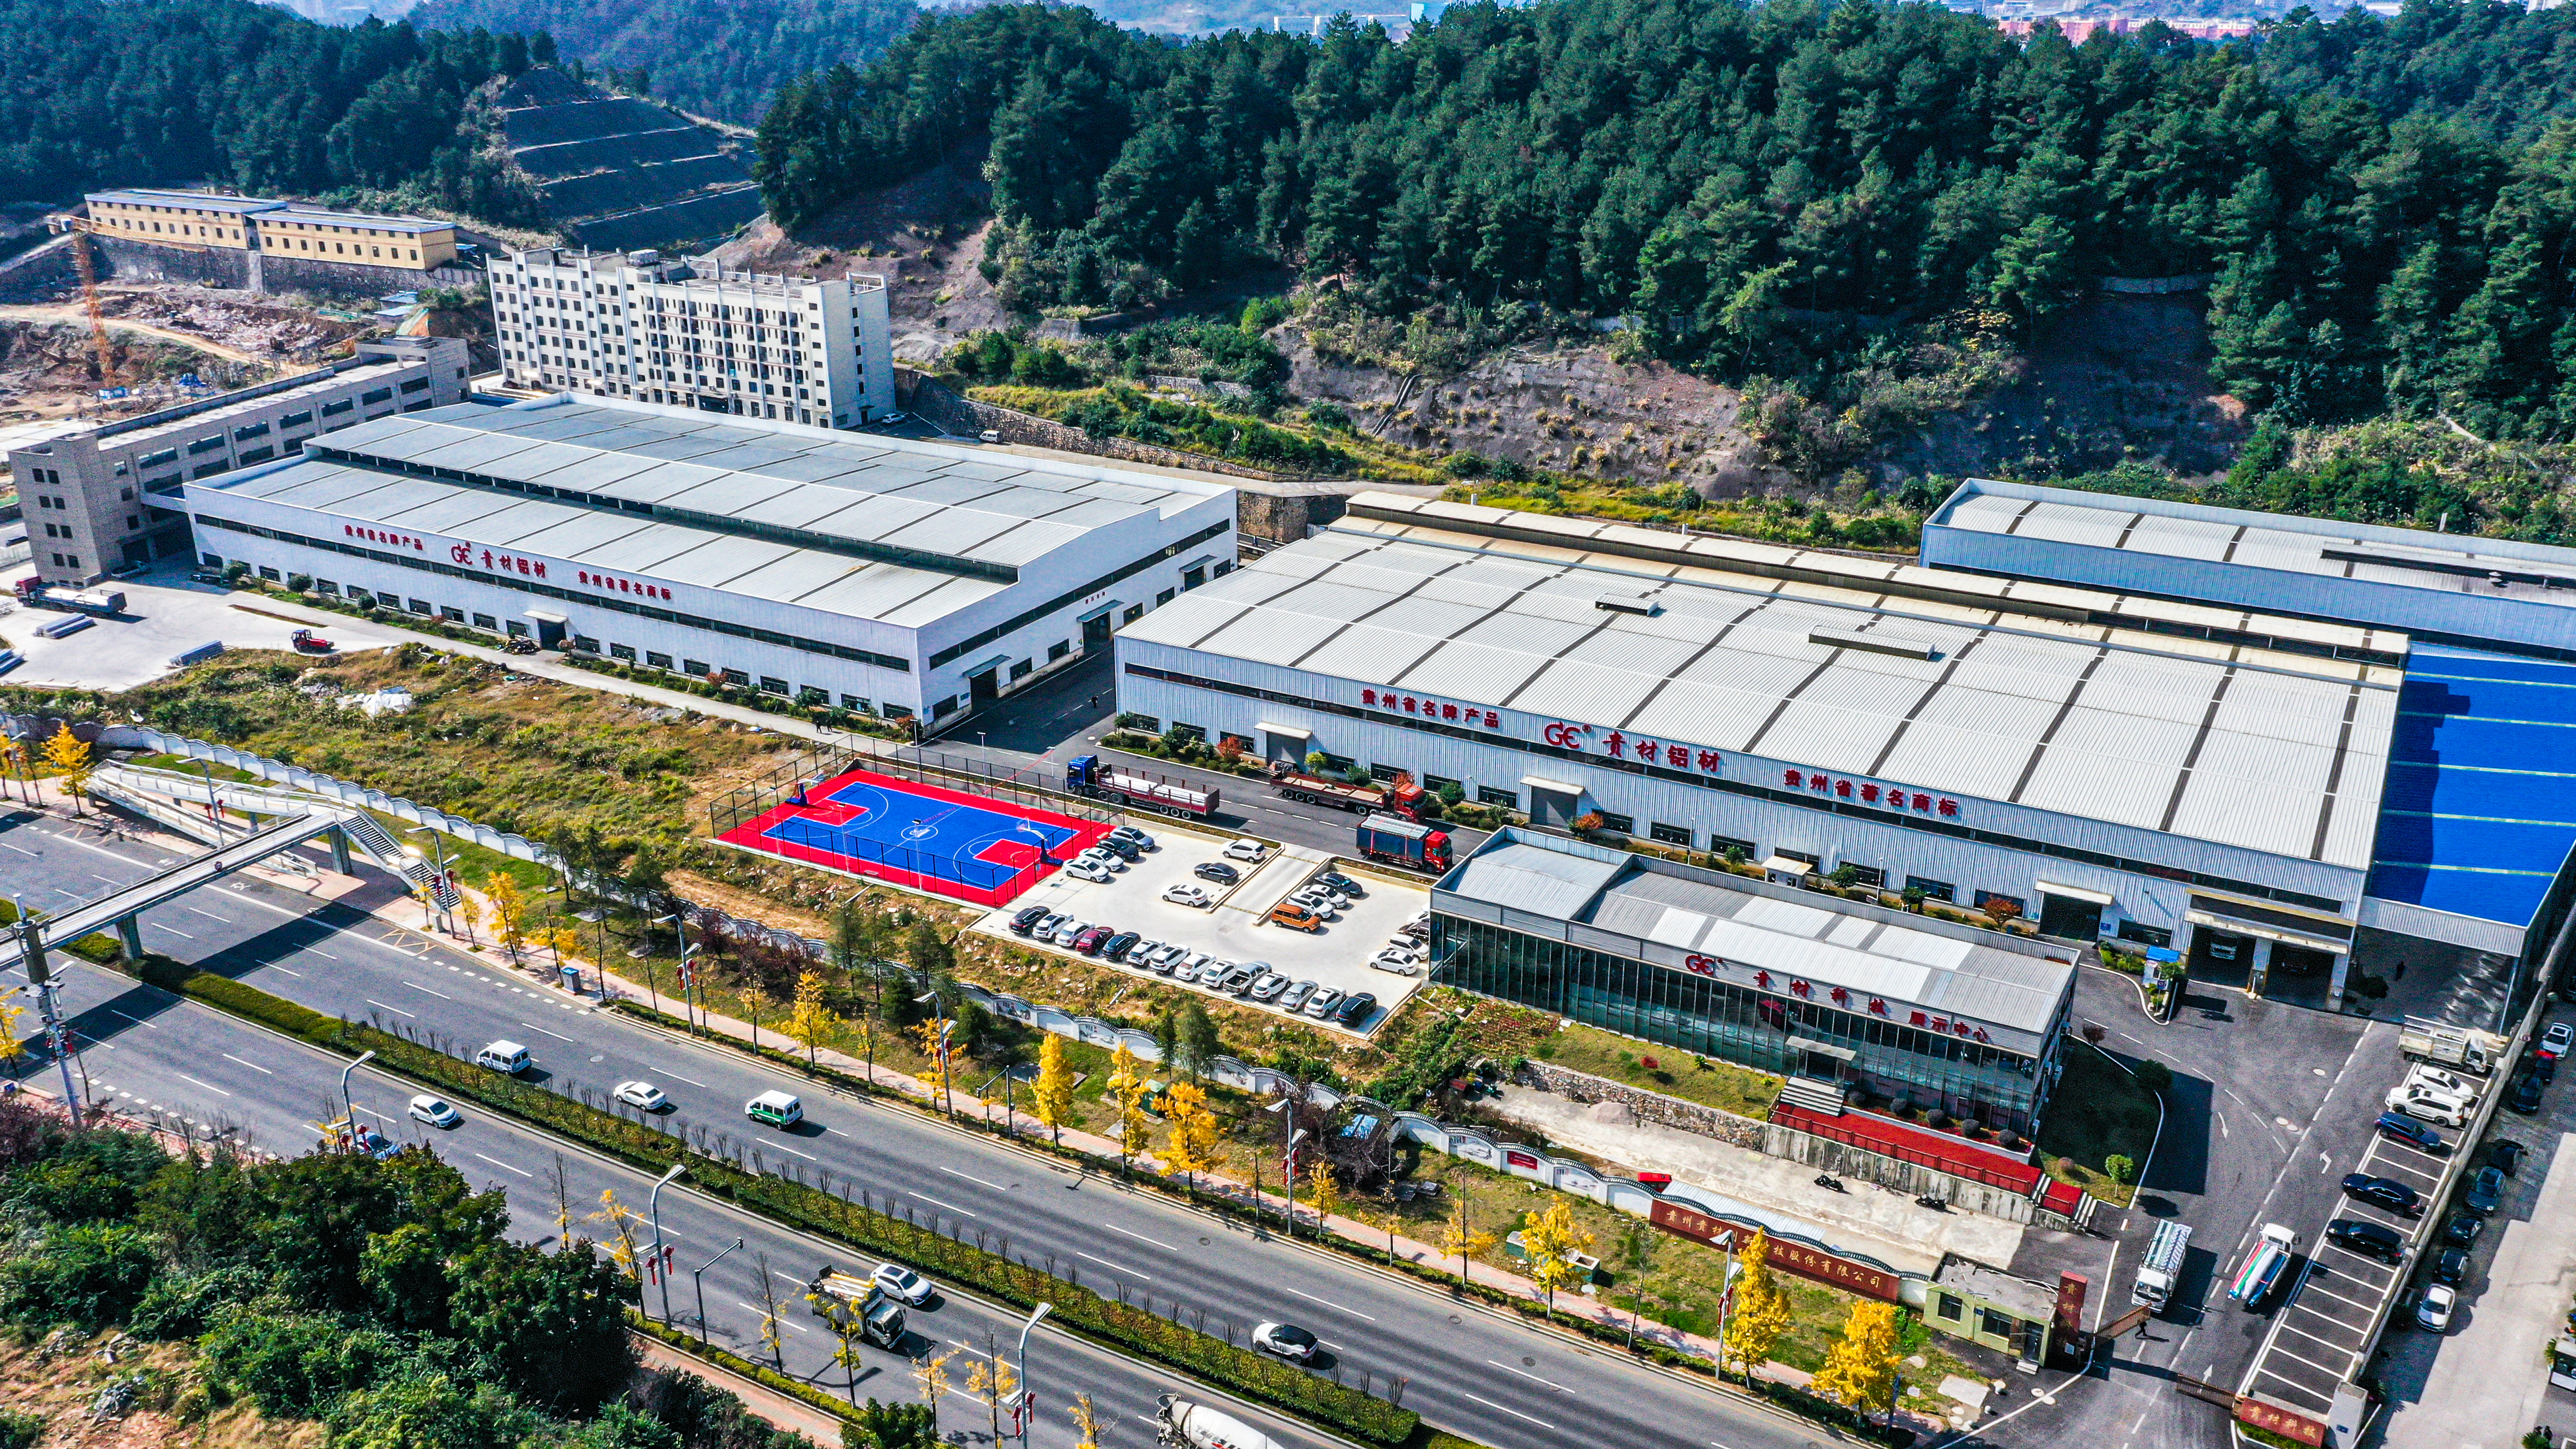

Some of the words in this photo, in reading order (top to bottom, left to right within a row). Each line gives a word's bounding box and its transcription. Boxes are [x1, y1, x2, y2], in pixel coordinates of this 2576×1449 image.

[1361, 689, 1499, 729] 贵州省名牌产品
[1784, 769, 1958, 817] 贵州省著名商标
